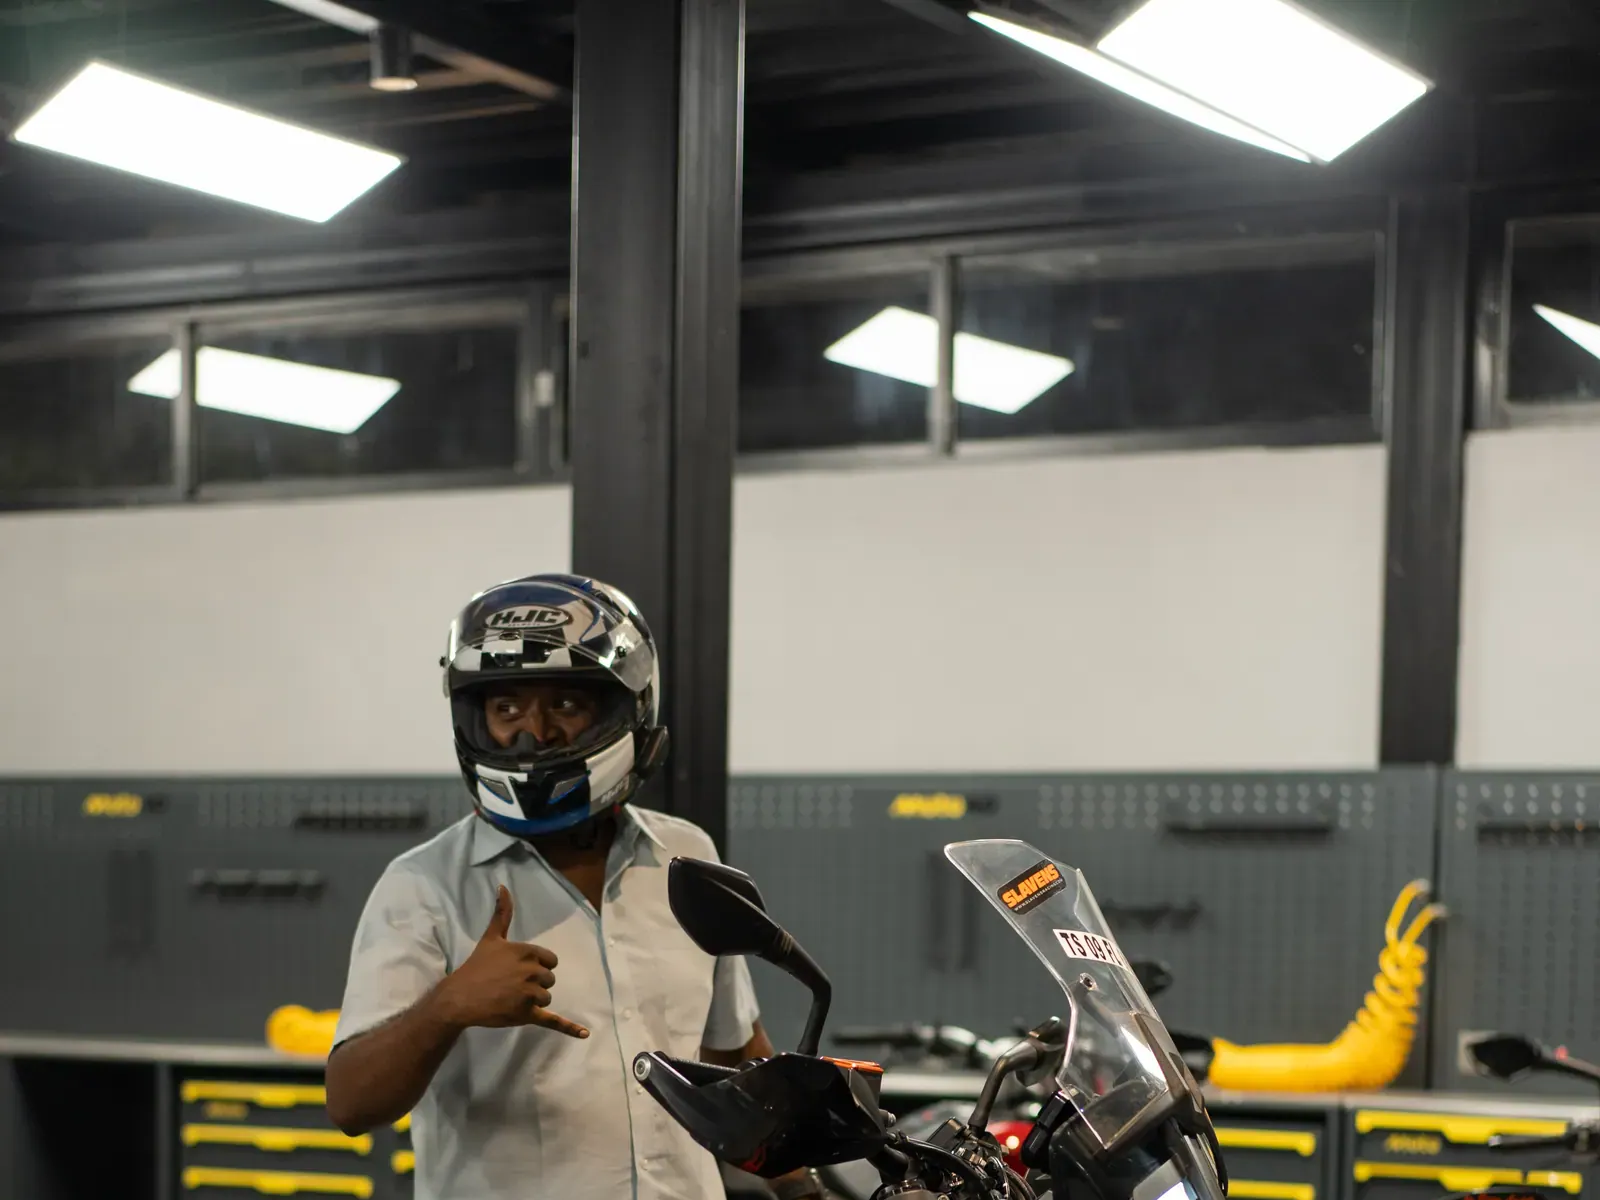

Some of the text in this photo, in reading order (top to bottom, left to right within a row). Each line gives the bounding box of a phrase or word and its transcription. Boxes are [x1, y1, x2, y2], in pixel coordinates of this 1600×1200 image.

[490, 609, 562, 626] HJC
[1002, 863, 1060, 909] SLAVENS
[1059, 932, 1087, 957] TS
[1084, 935, 1107, 961] 09
